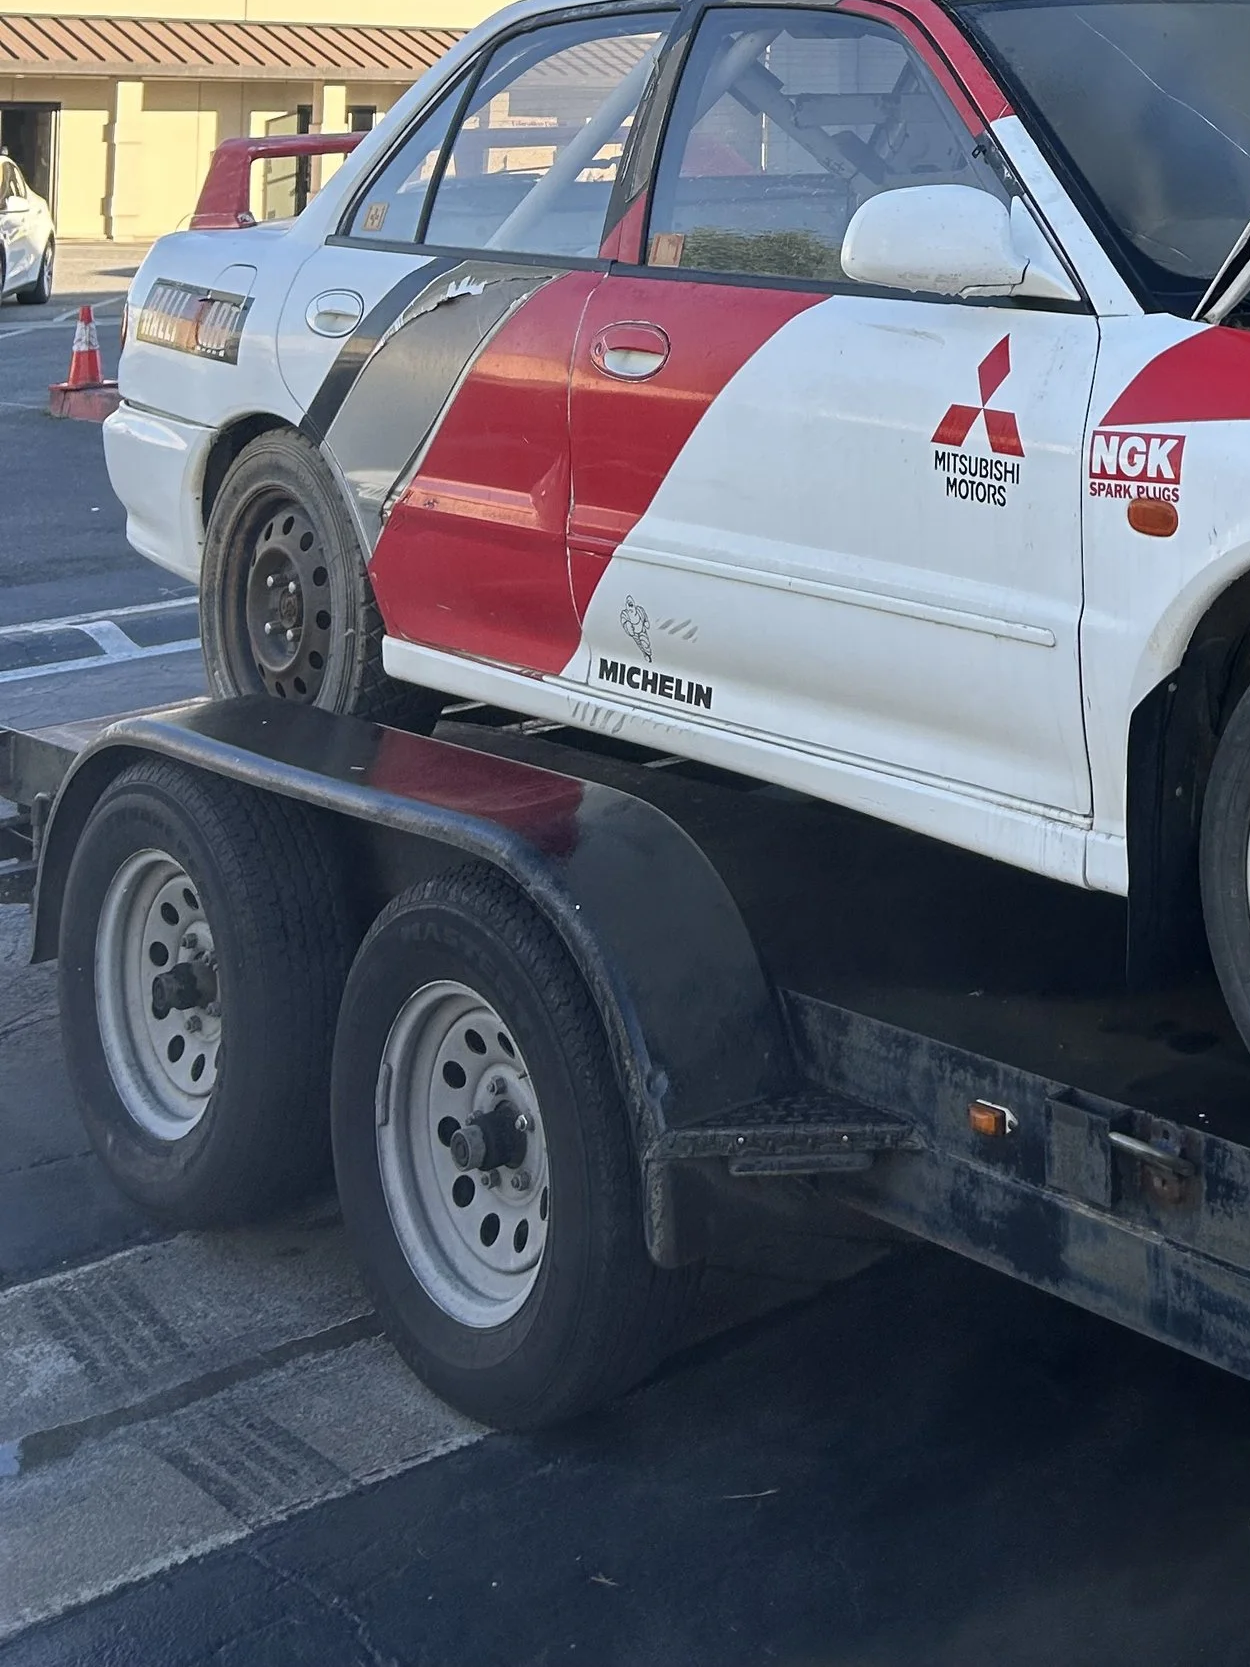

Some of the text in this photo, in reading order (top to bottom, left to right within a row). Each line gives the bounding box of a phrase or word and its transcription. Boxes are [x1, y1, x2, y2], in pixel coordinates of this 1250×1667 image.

[934, 450, 1020, 484] MITSUBISHI
[1092, 434, 1179, 479] NGK
[946, 476, 1007, 507] MOTORS
[1089, 482, 1180, 502] SPARK PLUGS
[598, 658, 713, 709] MICHELIN
